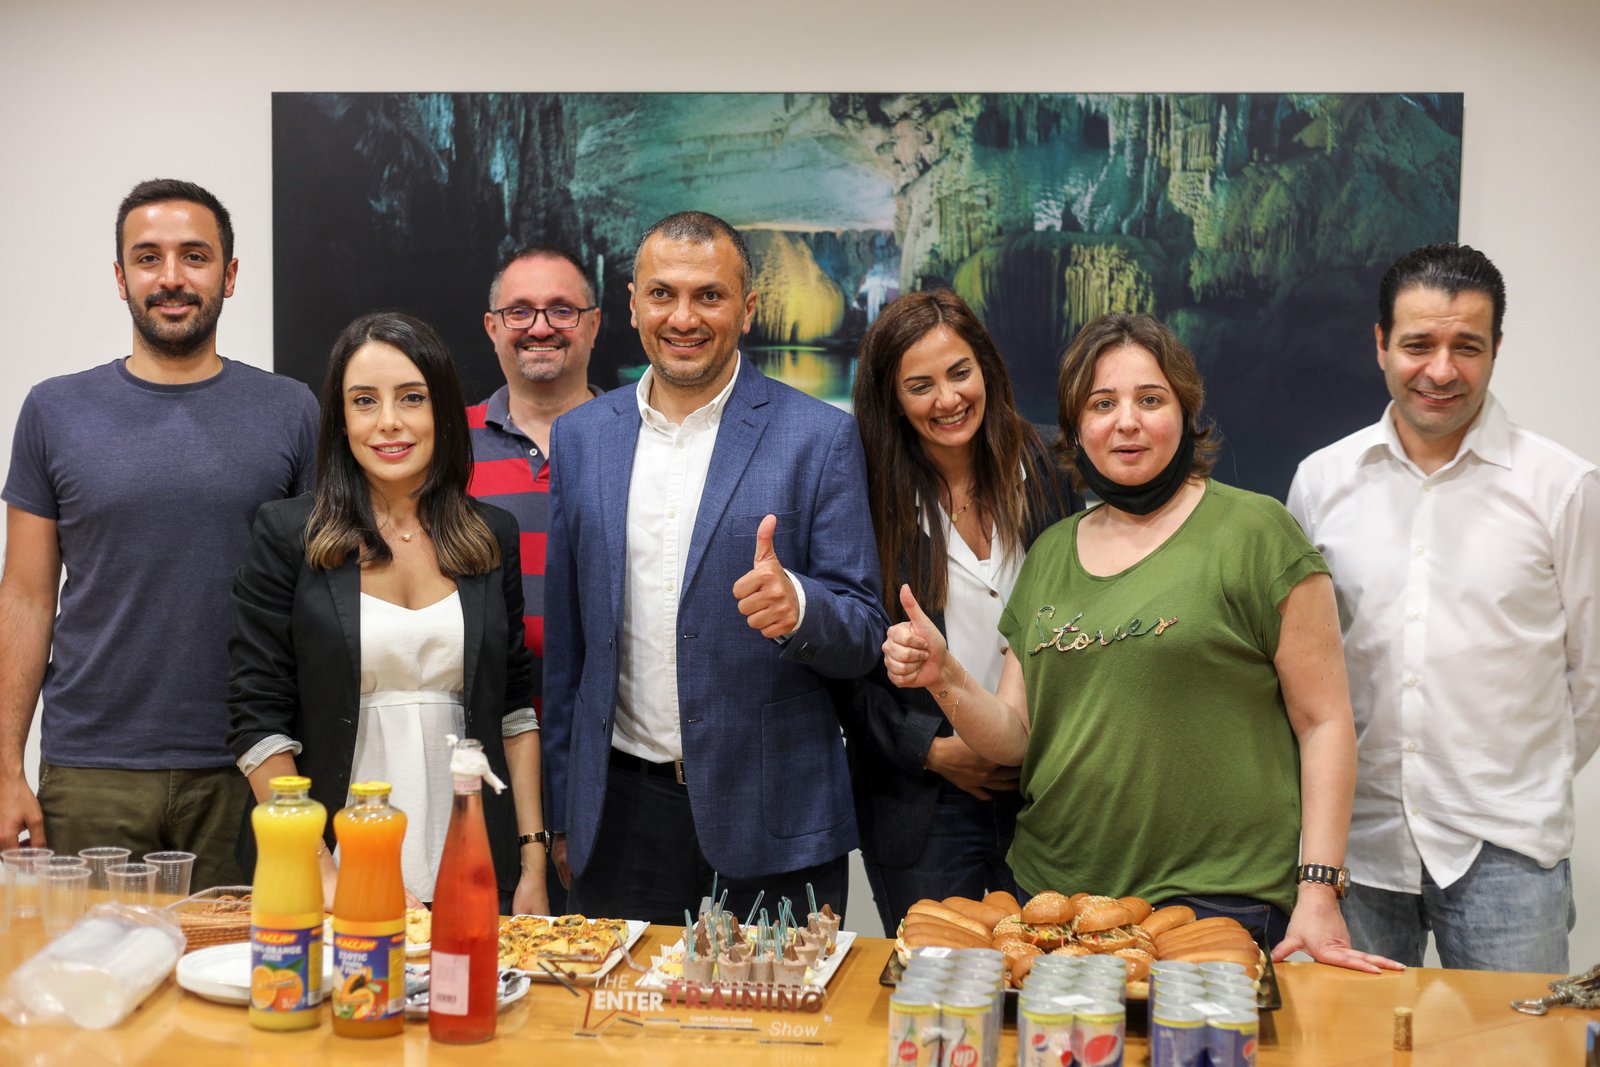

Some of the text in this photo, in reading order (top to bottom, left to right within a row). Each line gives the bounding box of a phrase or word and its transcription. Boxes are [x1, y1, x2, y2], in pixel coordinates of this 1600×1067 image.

[595, 974, 630, 989] THE
[593, 983, 824, 1014] ENTER TRAINING
[769, 1021, 819, 1039] Show
